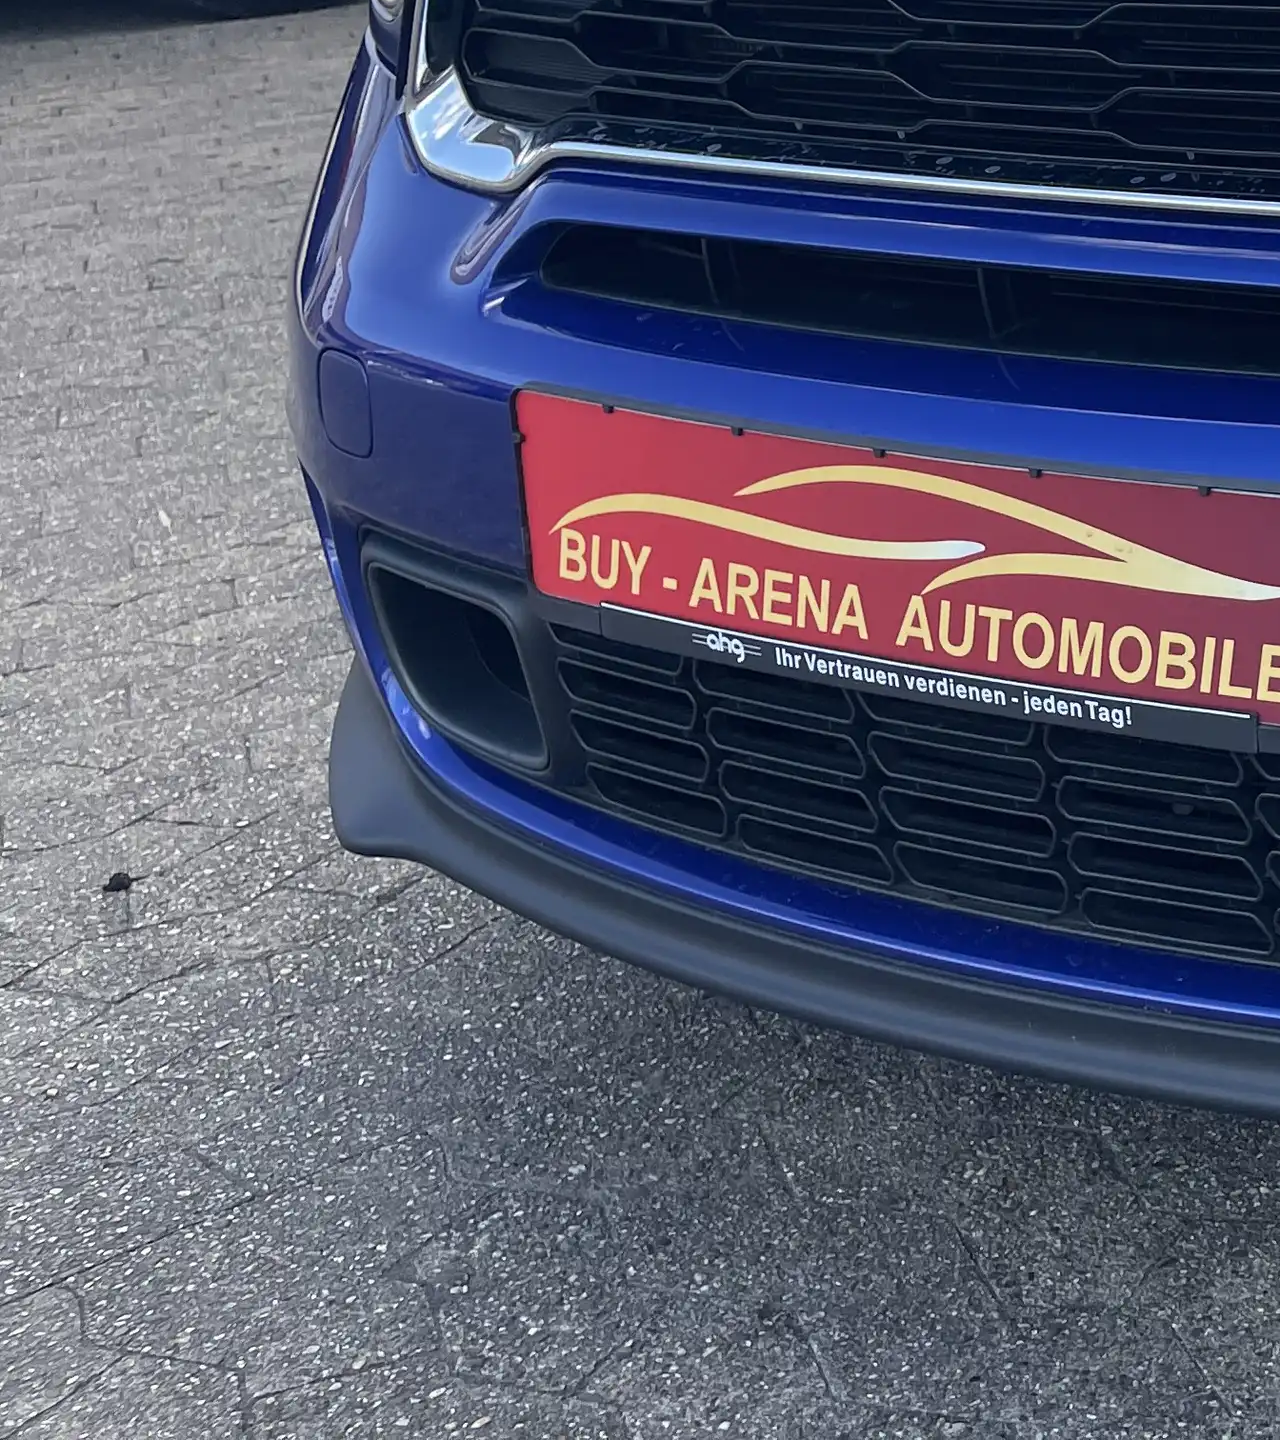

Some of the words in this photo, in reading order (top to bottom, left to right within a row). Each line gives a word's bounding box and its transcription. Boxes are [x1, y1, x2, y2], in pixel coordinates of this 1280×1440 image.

[559, 527, 652, 595] BUY
[688, 557, 869, 640] ARENA
[706, 631, 745, 663] ahg
[774, 647, 801, 669] Ihr
[804, 652, 900, 688] Vertrauen
[904, 674, 1006, 706] verdienen
[1024, 691, 1082, 718] jeden
[1085, 700, 1132, 729] Tag!
